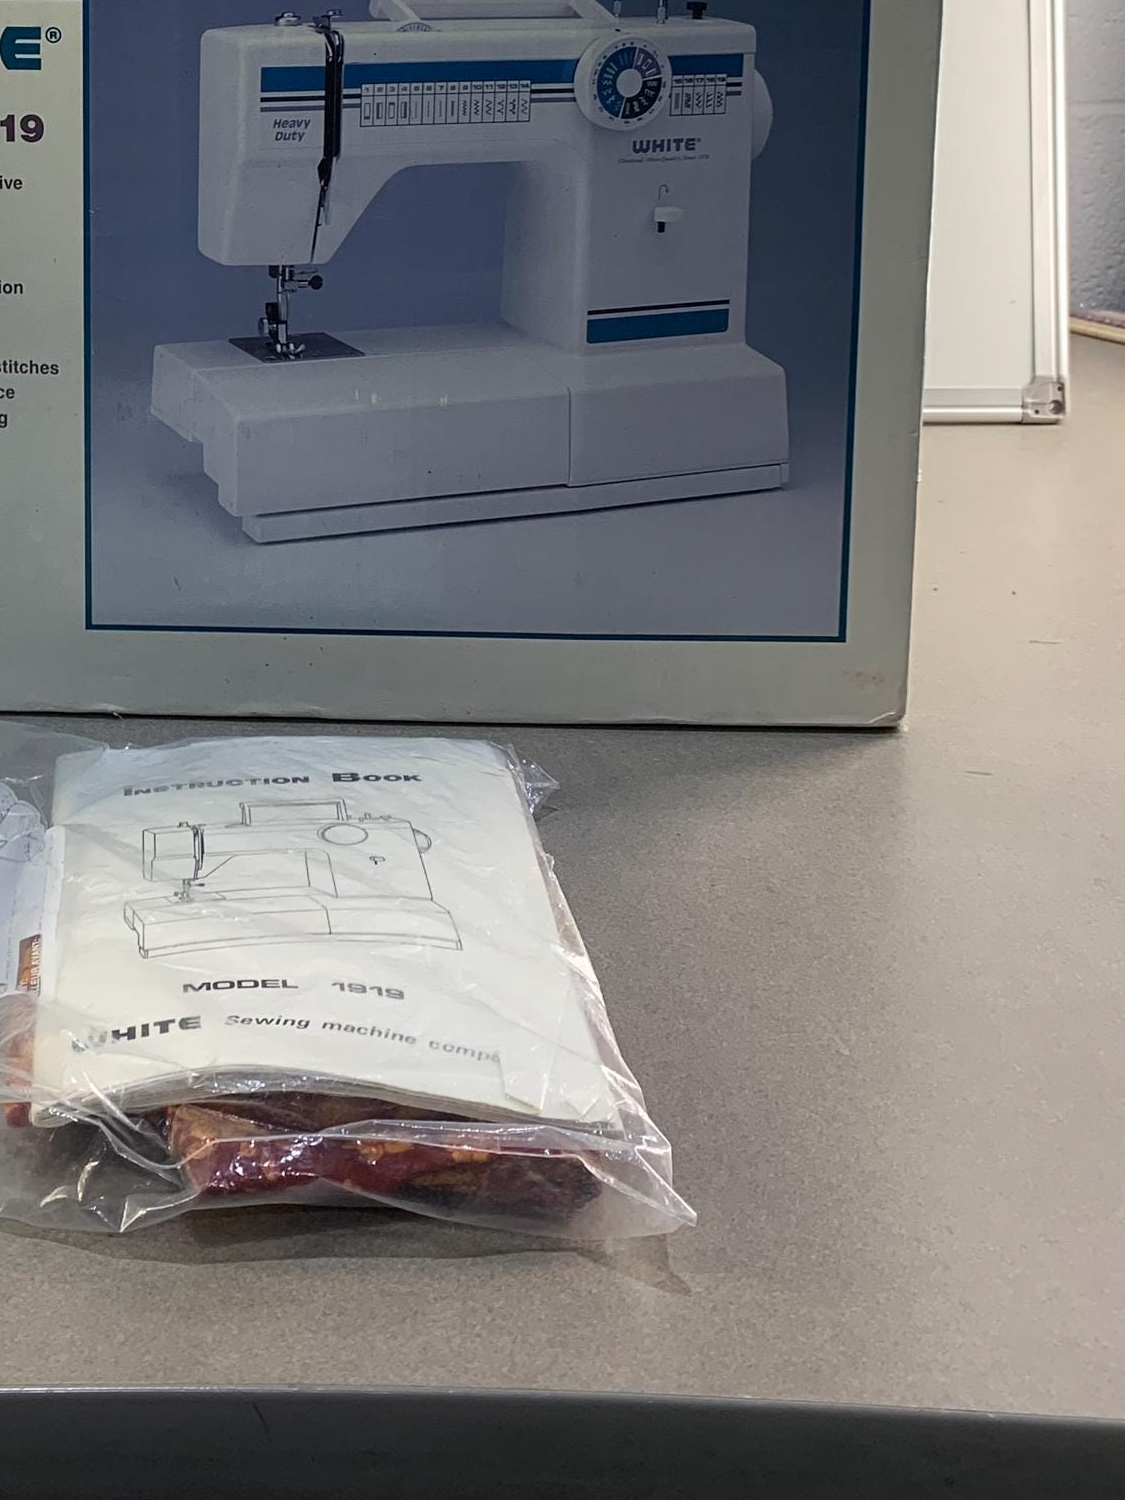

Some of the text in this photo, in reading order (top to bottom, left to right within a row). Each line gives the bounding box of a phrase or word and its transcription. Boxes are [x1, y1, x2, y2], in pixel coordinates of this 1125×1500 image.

[273, 118, 311, 130] Heavy
[275, 131, 306, 142] Duty
[331, 771, 423, 784] BOOK
[182, 979, 406, 1001] MODEL 1919
[224, 1015, 311, 1030] Sewing
[321, 1020, 418, 1045] machine
